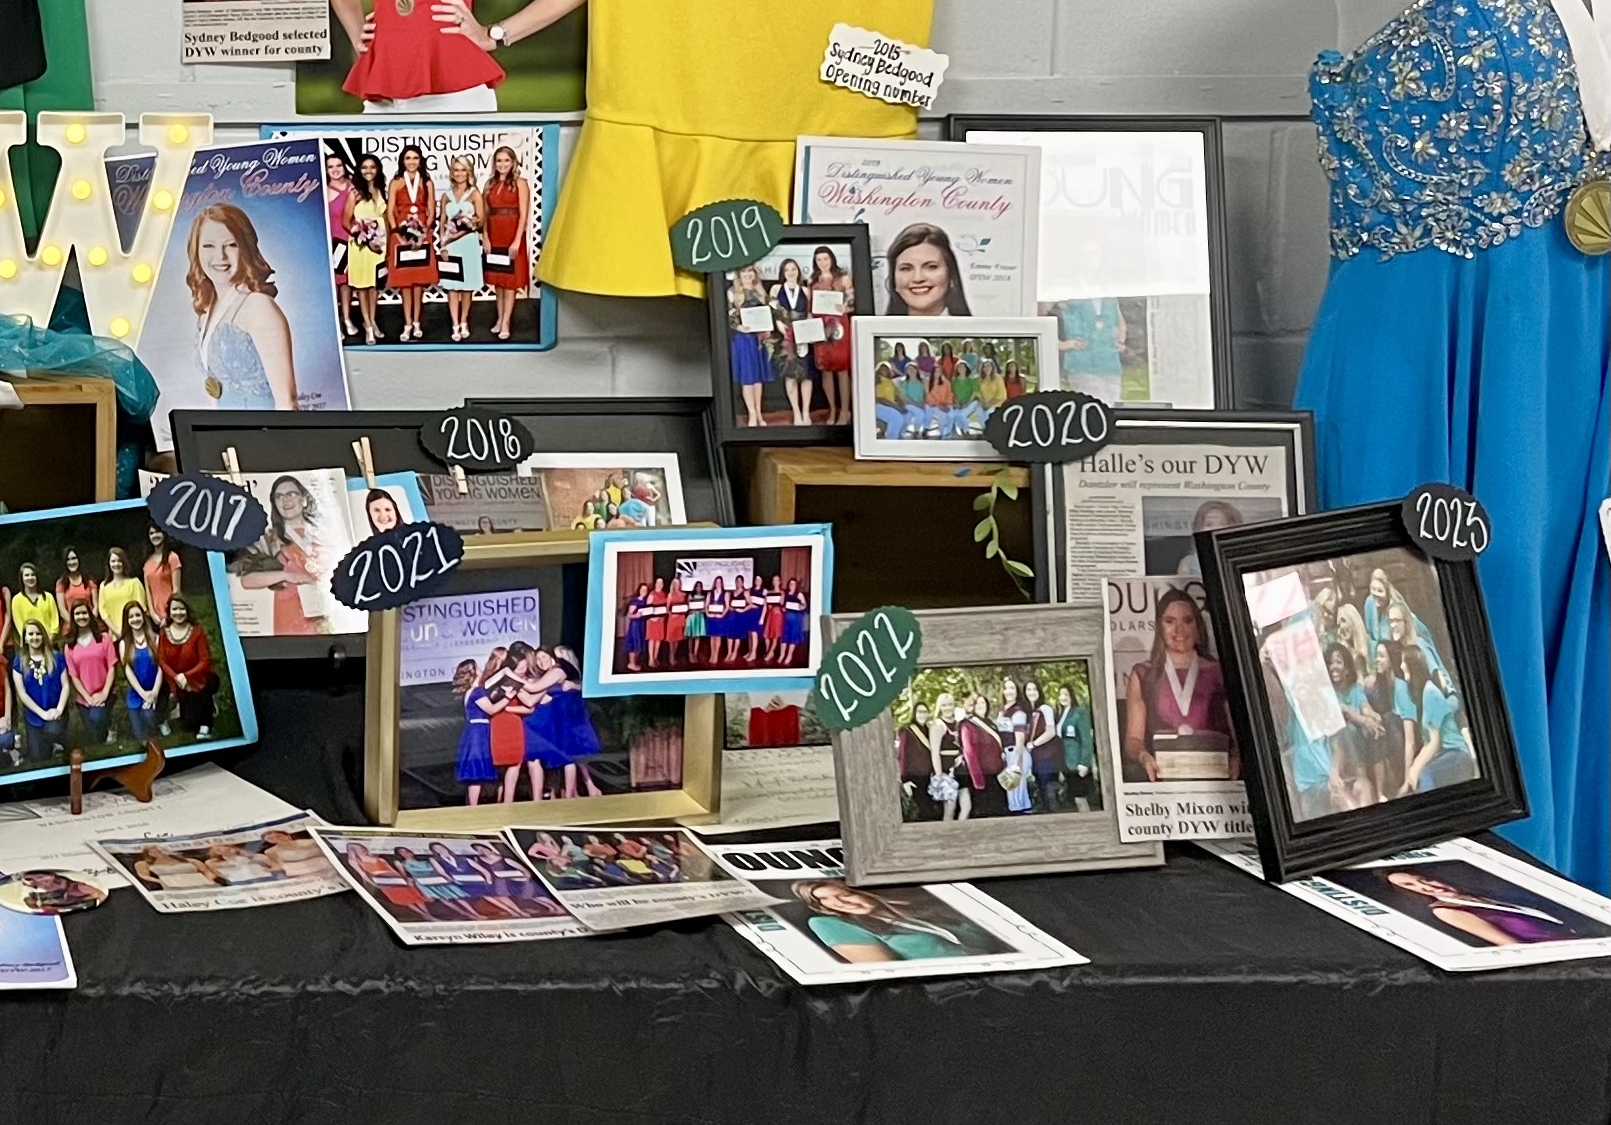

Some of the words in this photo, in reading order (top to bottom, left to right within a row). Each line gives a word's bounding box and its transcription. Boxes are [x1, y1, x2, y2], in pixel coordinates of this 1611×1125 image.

[184, 32, 226, 45] Sydney
[230, 30, 279, 43] Bedgood
[283, 28, 328, 39] selected
[185, 46, 217, 57] DYW
[221, 46, 261, 55] winner
[264, 45, 281, 55] for
[284, 44, 323, 56] county
[873, 39, 901, 60] 2015
[830, 42, 875, 76] Sydney
[875, 59, 934, 88] Bedgood
[826, 64, 880, 96] Opening
[883, 84, 932, 107] number
[210, 154, 261, 179] Young
[262, 147, 316, 169] Women
[826, 162, 916, 185] Distinguished
[916, 167, 960, 187] Young
[965, 168, 1014, 185] Women
[241, 169, 319, 203] County
[818, 180, 933, 215] Washington
[941, 186, 1012, 220] County
[687, 206, 771, 265] 2019
[440, 417, 520, 463] 2018
[1003, 402, 1107, 449] 2020
[1161, 459, 1197, 474] our
[1204, 455, 1268, 475] DYW
[1121, 480, 1137, 489] will
[1140, 481, 1181, 491] represent
[1184, 481, 1236, 491] Washington
[1238, 481, 1271, 491] County
[165, 481, 247, 541] 2017
[1416, 492, 1487, 553] 2023
[348, 529, 461, 603] 2021
[820, 613, 914, 722] 2022
[1126, 803, 1170, 819] Shelby
[1177, 802, 1223, 815] Mixon
[1128, 823, 1173, 838] county
[1179, 820, 1219, 834] DYW
[1224, 820, 1253, 833] title
[163, 898, 210, 911] Haley
[605, 899, 631, 909] will
[651, 894, 708, 904] county's
[504, 930, 516, 938] is
[518, 928, 577, 939] county's
